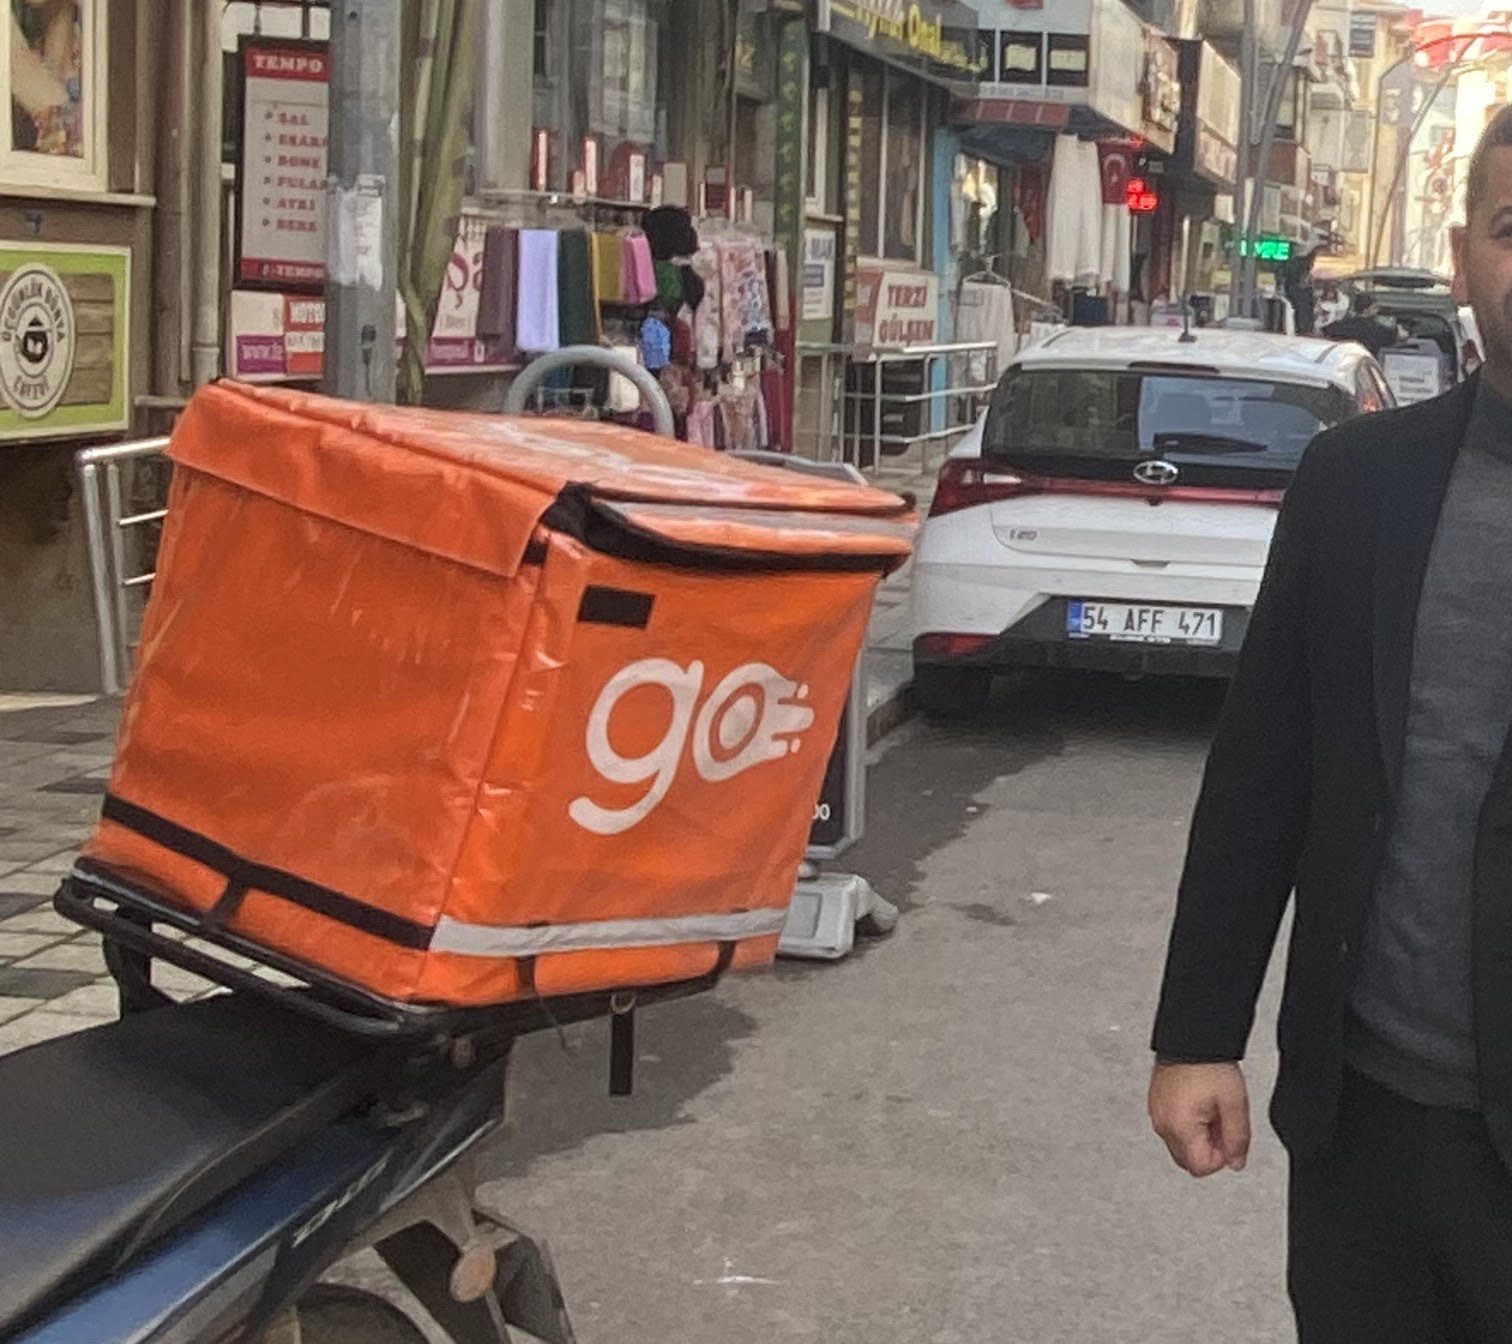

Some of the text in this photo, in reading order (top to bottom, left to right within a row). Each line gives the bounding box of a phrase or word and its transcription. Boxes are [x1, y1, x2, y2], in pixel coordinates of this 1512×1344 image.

[252, 55, 323, 74] TEMPO
[1083, 606, 1217, 637] 54 AFF 471
[569, 657, 815, 836] go
